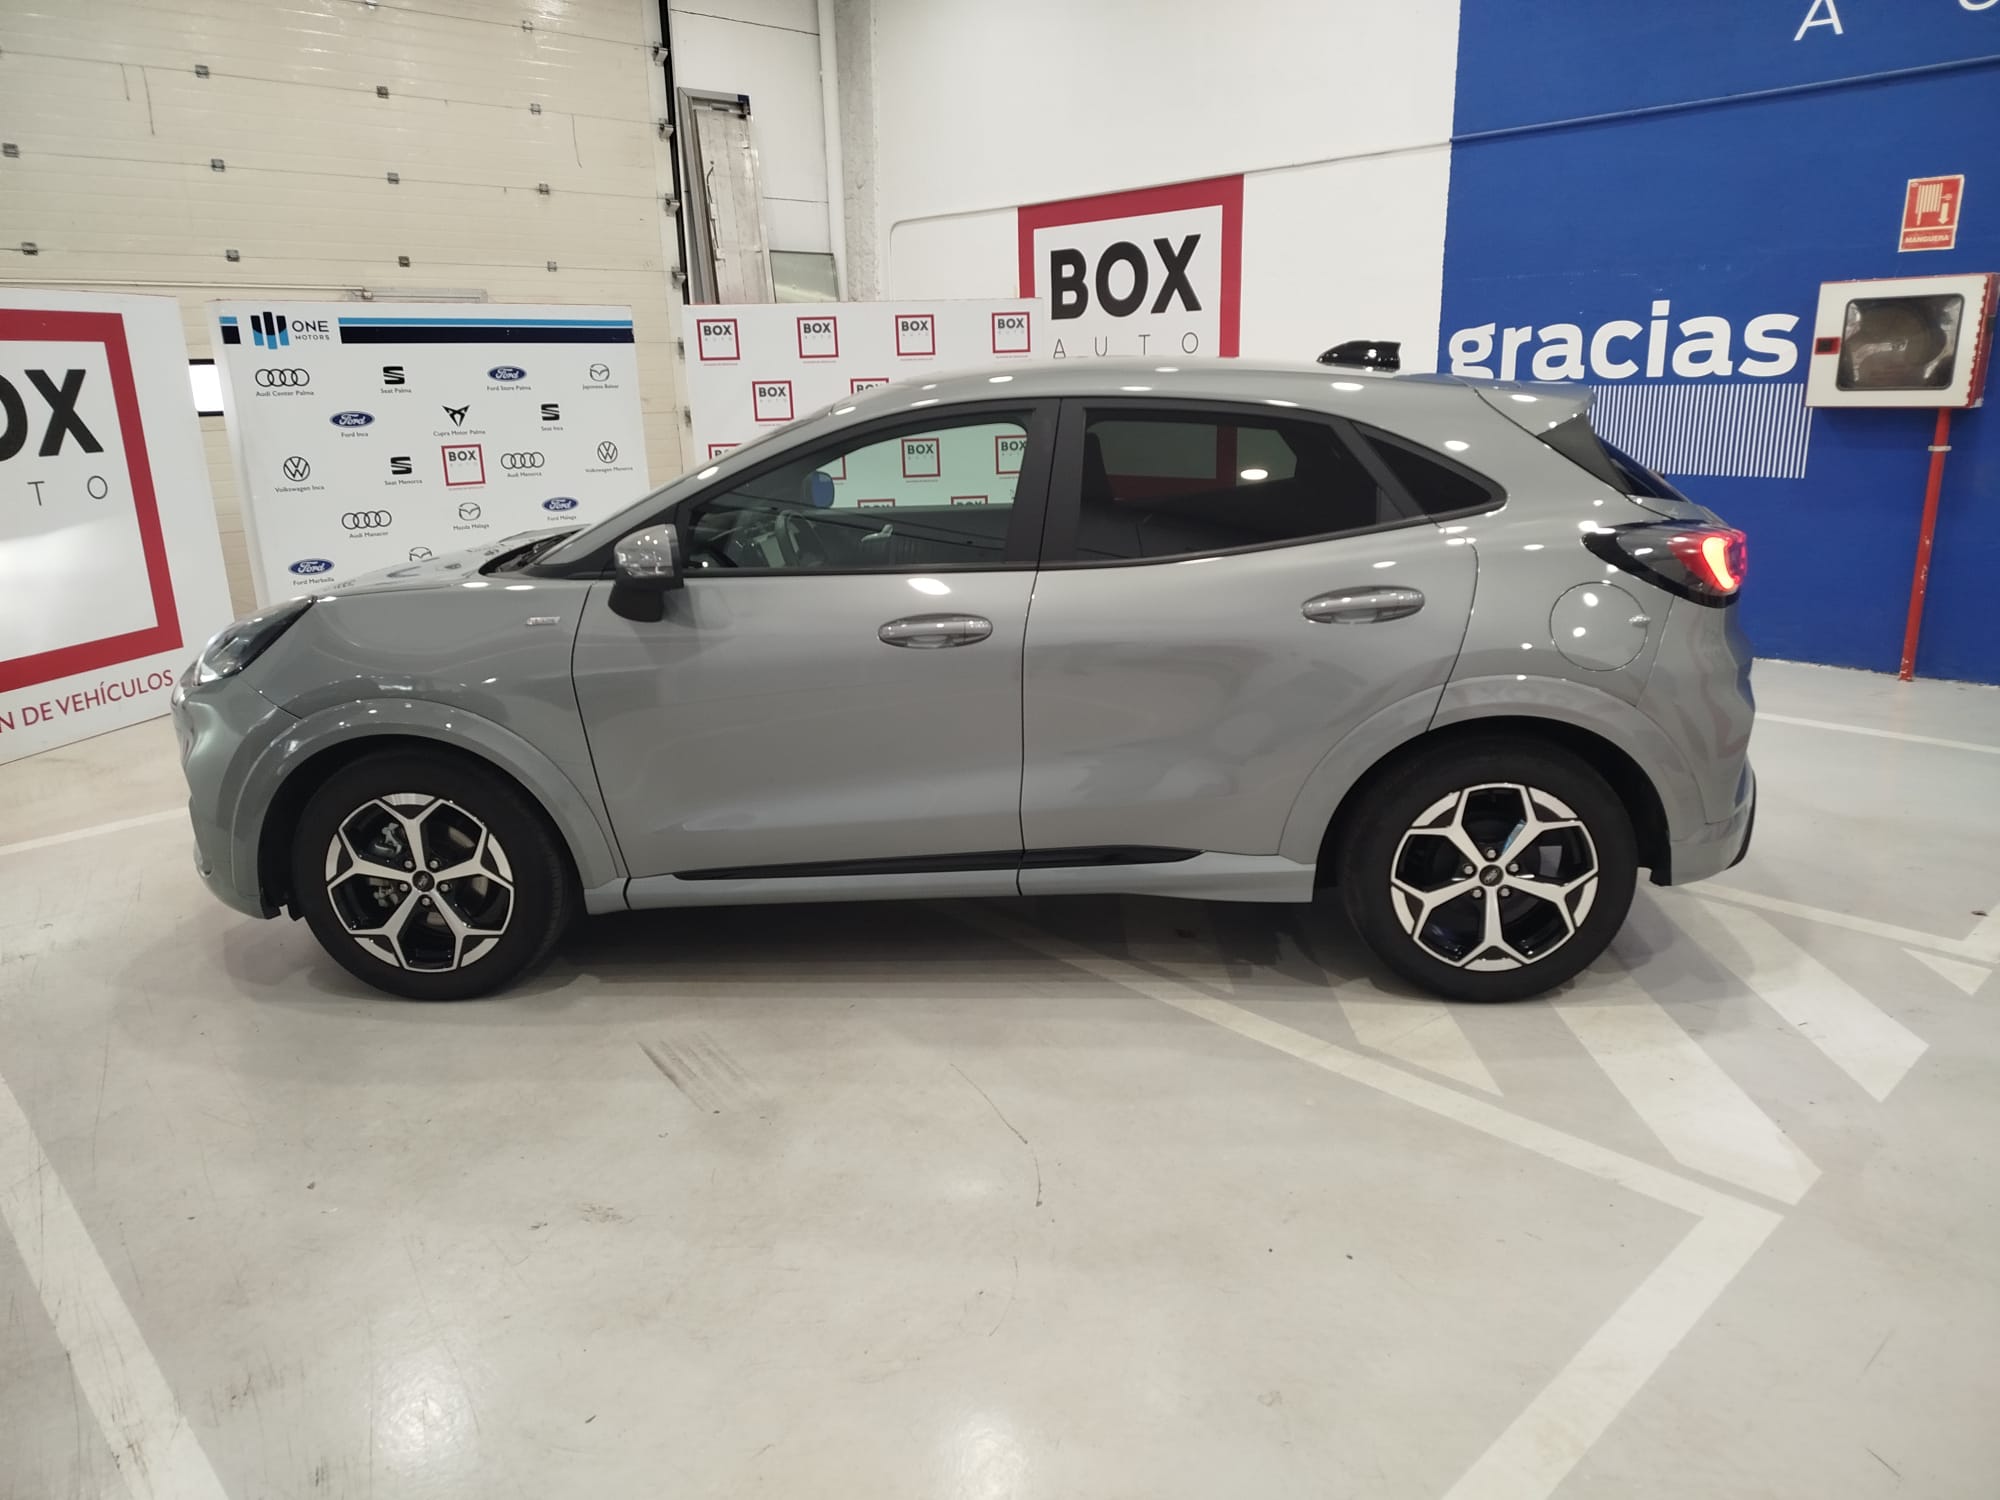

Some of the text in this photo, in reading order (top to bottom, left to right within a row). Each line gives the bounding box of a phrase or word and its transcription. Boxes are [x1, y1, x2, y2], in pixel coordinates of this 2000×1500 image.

[1050, 233, 1202, 320] BOX
[292, 320, 329, 333] ONE
[803, 322, 832, 334] BOX
[901, 320, 929, 332] BOX
[997, 317, 1024, 329] BOX
[703, 324, 732, 336] BOX
[1053, 332, 1199, 359] AUTO
[1448, 299, 1800, 381] gracias
[758, 386, 787, 397] BOX
[907, 443, 934, 455] BOX
[448, 450, 477, 462] BOX
[22, 702, 54, 726] DE
[56, 669, 174, 715] VEHÍCULOS
